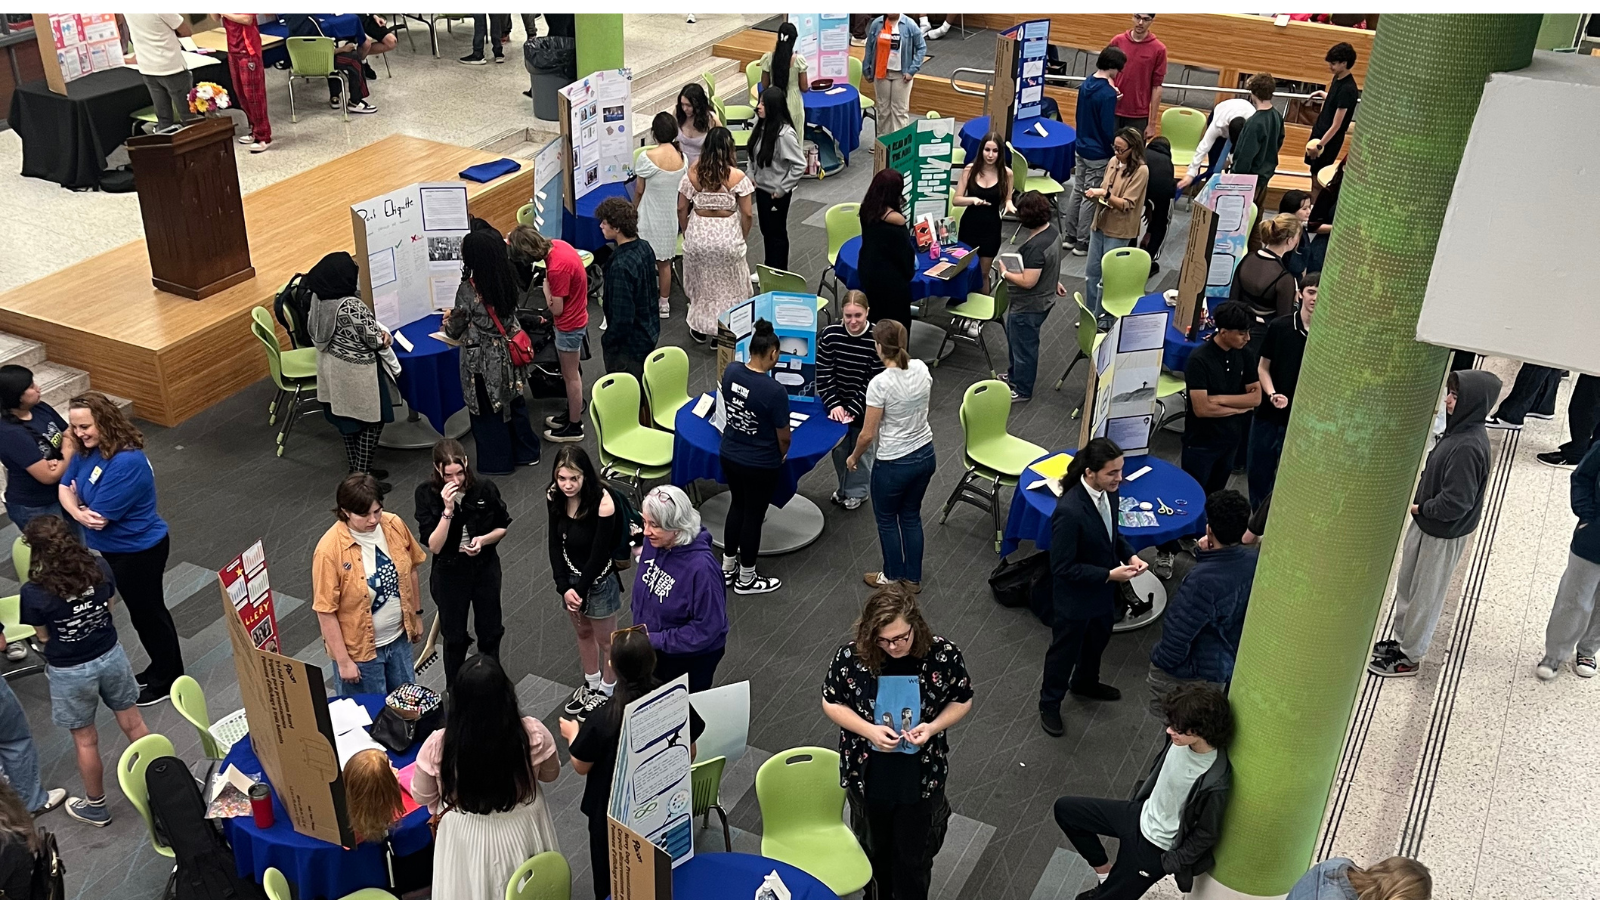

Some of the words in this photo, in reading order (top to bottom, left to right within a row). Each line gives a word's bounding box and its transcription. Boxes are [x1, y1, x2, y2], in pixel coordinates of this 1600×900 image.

[73, 600, 94, 614] SAIC
[283, 663, 297, 684] Pacon
[632, 839, 643, 863] Pacon
